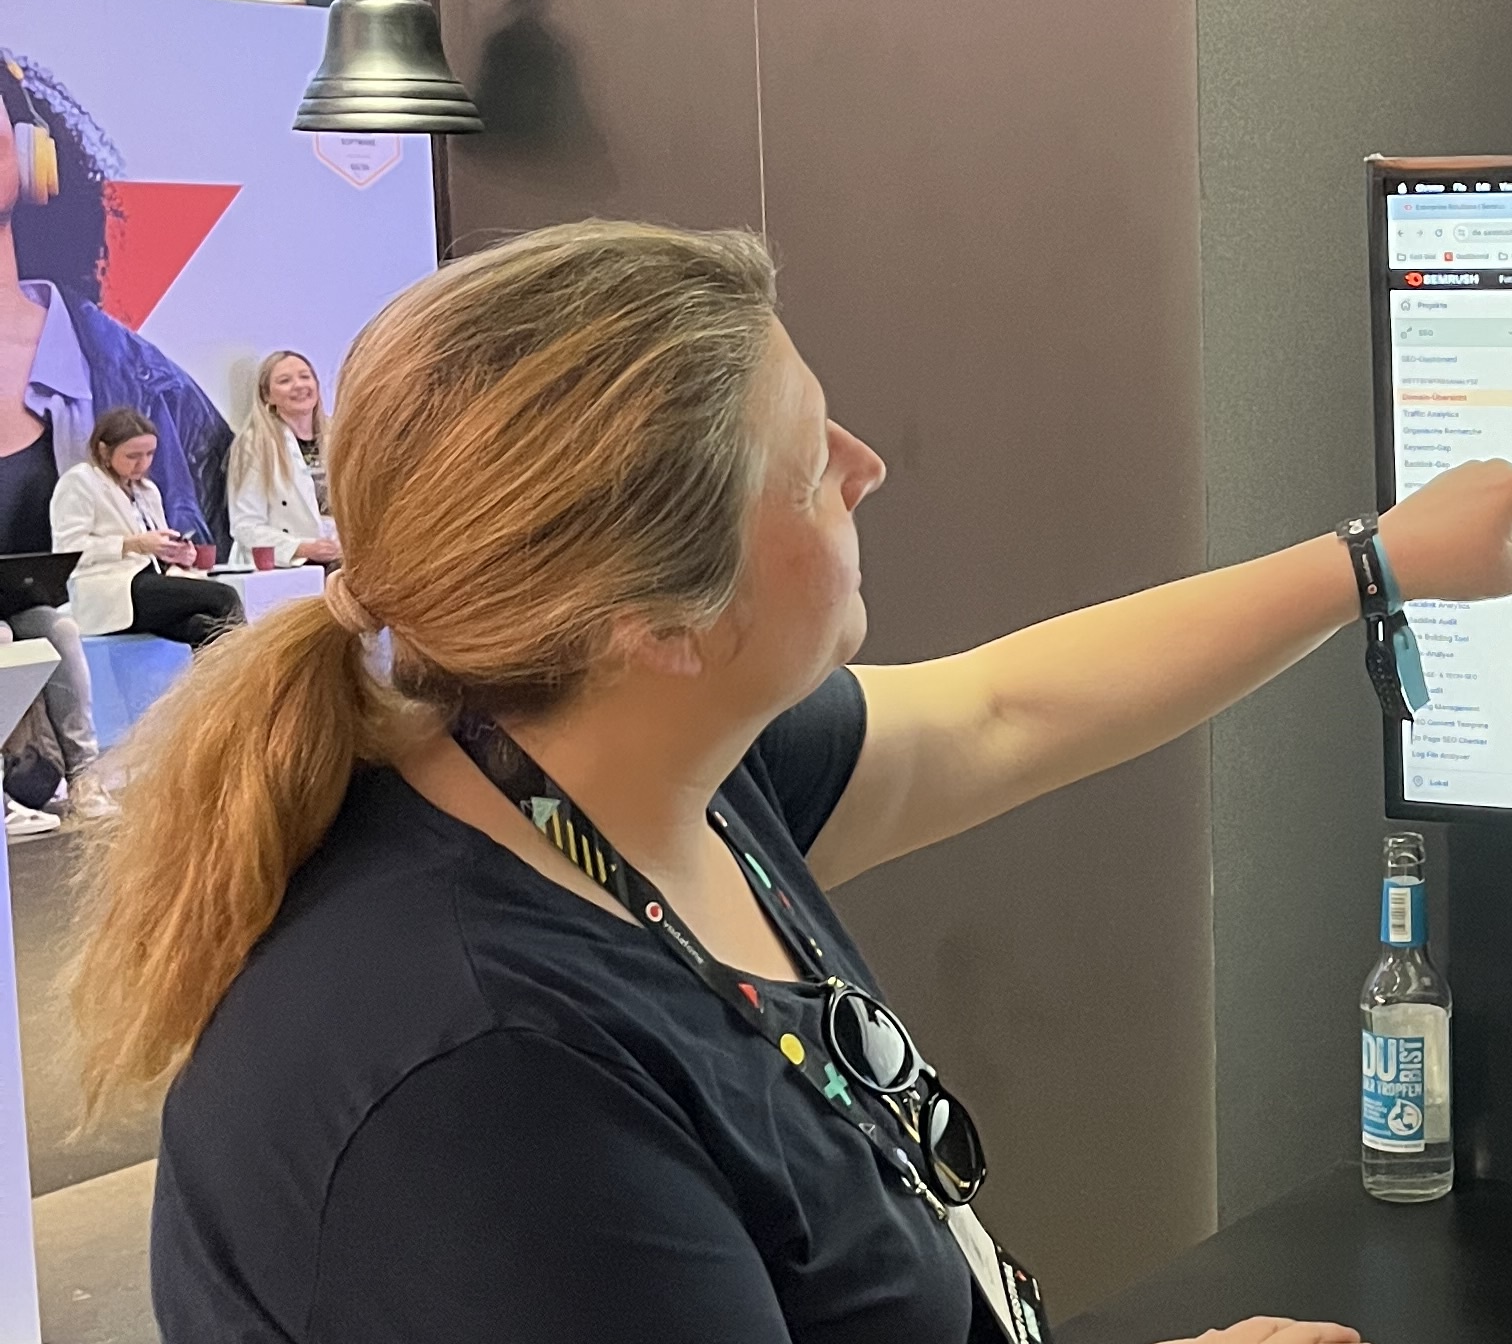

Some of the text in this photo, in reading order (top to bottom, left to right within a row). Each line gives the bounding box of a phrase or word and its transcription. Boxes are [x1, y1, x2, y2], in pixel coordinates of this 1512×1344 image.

[1423, 274, 1479, 285] SEMRUSH
[663, 920, 704, 965] vodafone
[1362, 1031, 1422, 1082] DU BIST
